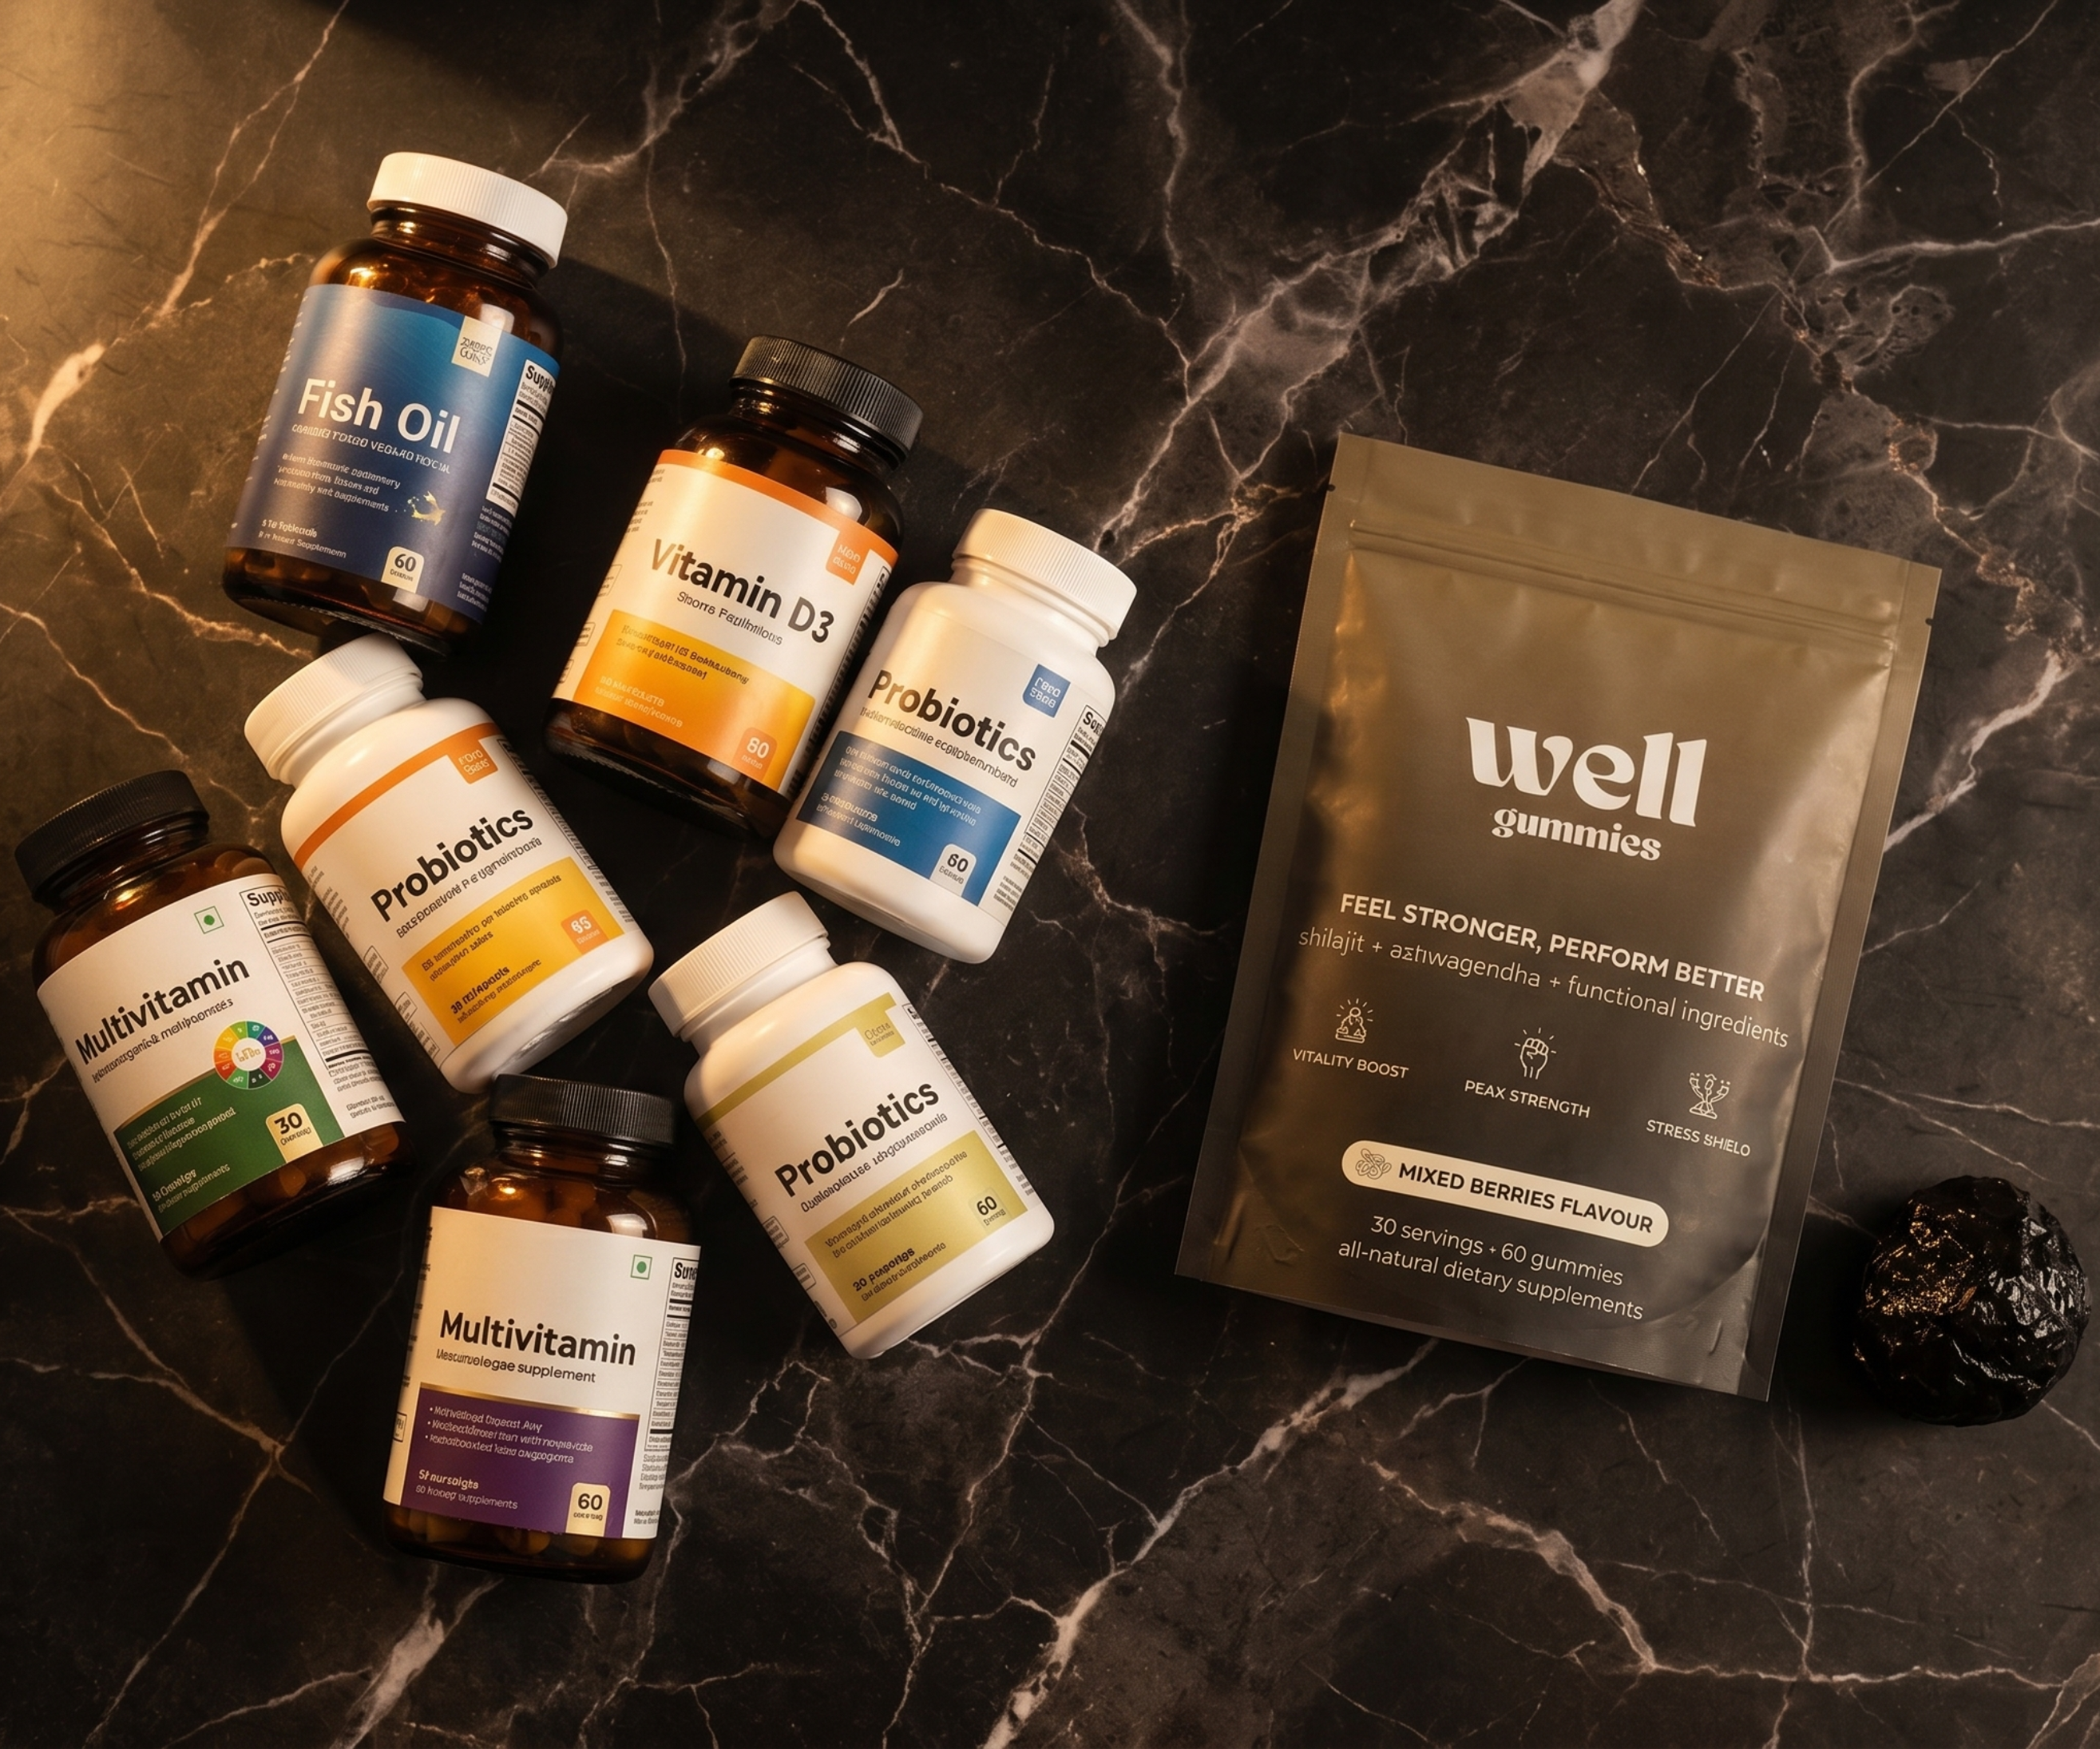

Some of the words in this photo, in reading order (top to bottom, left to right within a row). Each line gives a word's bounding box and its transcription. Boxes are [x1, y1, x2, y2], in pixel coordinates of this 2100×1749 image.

[298, 378, 382, 430] Fish
[398, 403, 460, 454] Oil
[394, 553, 416, 572] 60
[652, 538, 782, 619] Vitamin
[788, 597, 834, 643] D3
[868, 669, 1036, 771] Probiotics
[1466, 717, 1706, 827] well
[370, 809, 533, 922] Probiotics
[1492, 808, 1661, 861] gummies
[1341, 894, 1396, 920] FEEL
[1402, 904, 1542, 954] STRONGER,
[1550, 934, 1669, 977] PERFORM
[1675, 962, 1764, 1001] BETTER
[75, 959, 250, 1065] Multivitamin
[1299, 927, 1365, 956] shilajit
[1569, 975, 1676, 1017] functional
[1682, 1001, 1788, 1047] ingredients
[1294, 1049, 1353, 1068] VITALITY
[1357, 1059, 1409, 1078] BOOST
[275, 1113, 302, 1133] 30
[1465, 1081, 1506, 1099] PEAX
[1510, 1090, 1590, 1118] STRENGTH
[1646, 1120, 1700, 1142] STRESS
[775, 1084, 940, 1199] Probiotics
[977, 1196, 997, 1215] 60
[1400, 1164, 1464, 1188] MIXED
[1471, 1179, 1554, 1209] BERRIES
[1561, 1198, 1651, 1231] FLAVOUR
[1339, 1241, 1438, 1273] all-natural
[1444, 1261, 1512, 1292] dietary
[1516, 1275, 1643, 1320] supplements
[1371, 1216, 1397, 1235] 30
[1401, 1226, 1483, 1255] servings
[1502, 1243, 1526, 1263] 60
[1531, 1250, 1623, 1287] gummies
[440, 1310, 636, 1366] Multivitamin
[517, 1363, 596, 1383] supplement
[579, 1494, 602, 1509] 60
